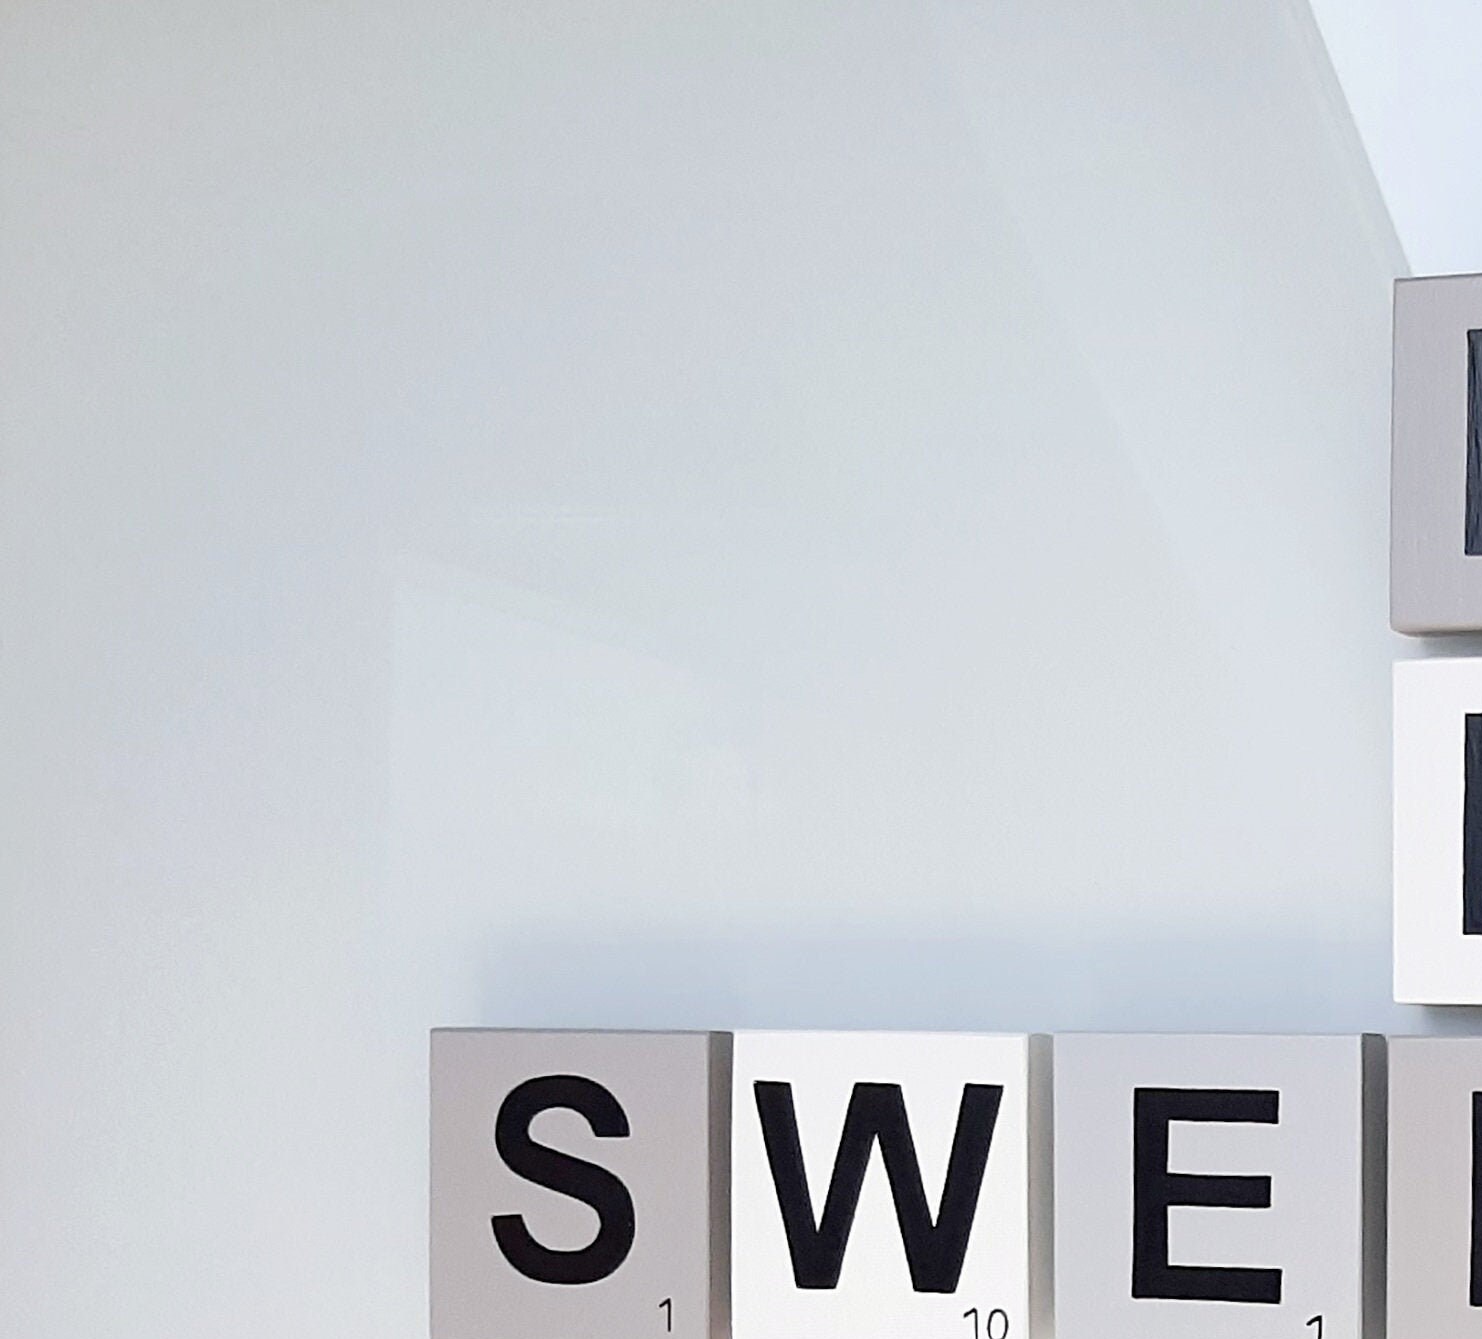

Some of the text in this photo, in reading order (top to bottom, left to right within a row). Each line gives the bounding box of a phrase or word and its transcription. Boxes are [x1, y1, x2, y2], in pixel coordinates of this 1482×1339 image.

[491, 1075, 635, 1284] S
[754, 1081, 1003, 1294] W
[1132, 1088, 1282, 1304] E
[658, 1298, 672, 1332] 1
